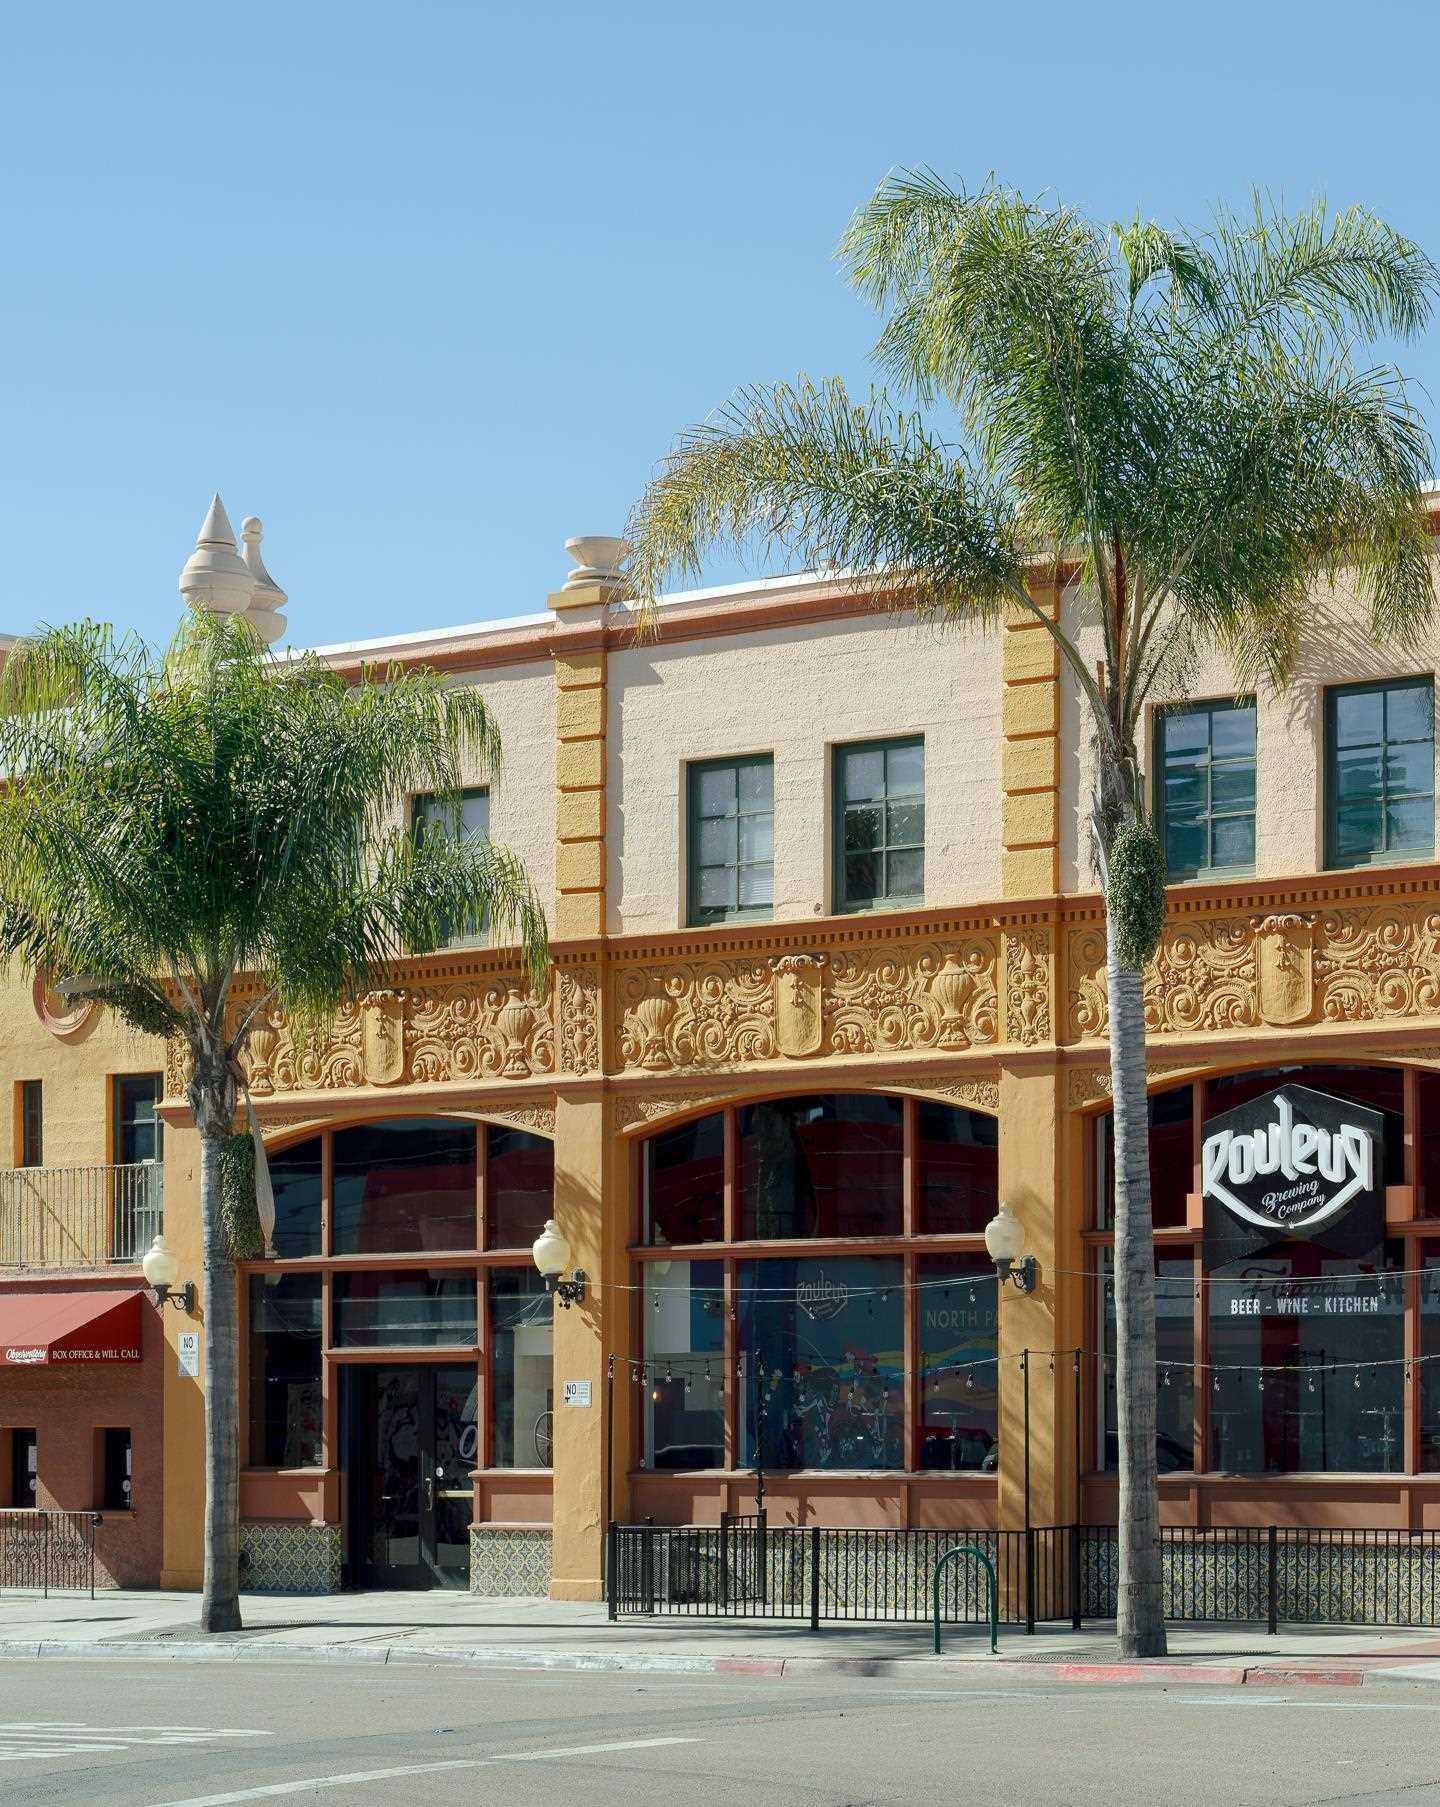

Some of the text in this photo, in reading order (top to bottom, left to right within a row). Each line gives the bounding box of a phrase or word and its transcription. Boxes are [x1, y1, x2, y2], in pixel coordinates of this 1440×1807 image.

[1262, 1180, 1320, 1214] Brewing
[1278, 1192, 1326, 1219] Company
[1230, 1299, 1261, 1315] BEER
[1277, 1298, 1309, 1314] WINE
[1325, 1296, 1378, 1313] KITCHEN
[926, 1310, 977, 1328] NORTH
[183, 1336, 194, 1348] NO
[52, 1350, 68, 1360] BOX
[68, 1350, 94, 1359] OFFICE
[102, 1349, 119, 1359] WILL
[121, 1349, 140, 1359] CALL
[566, 1384, 577, 1396] NO
